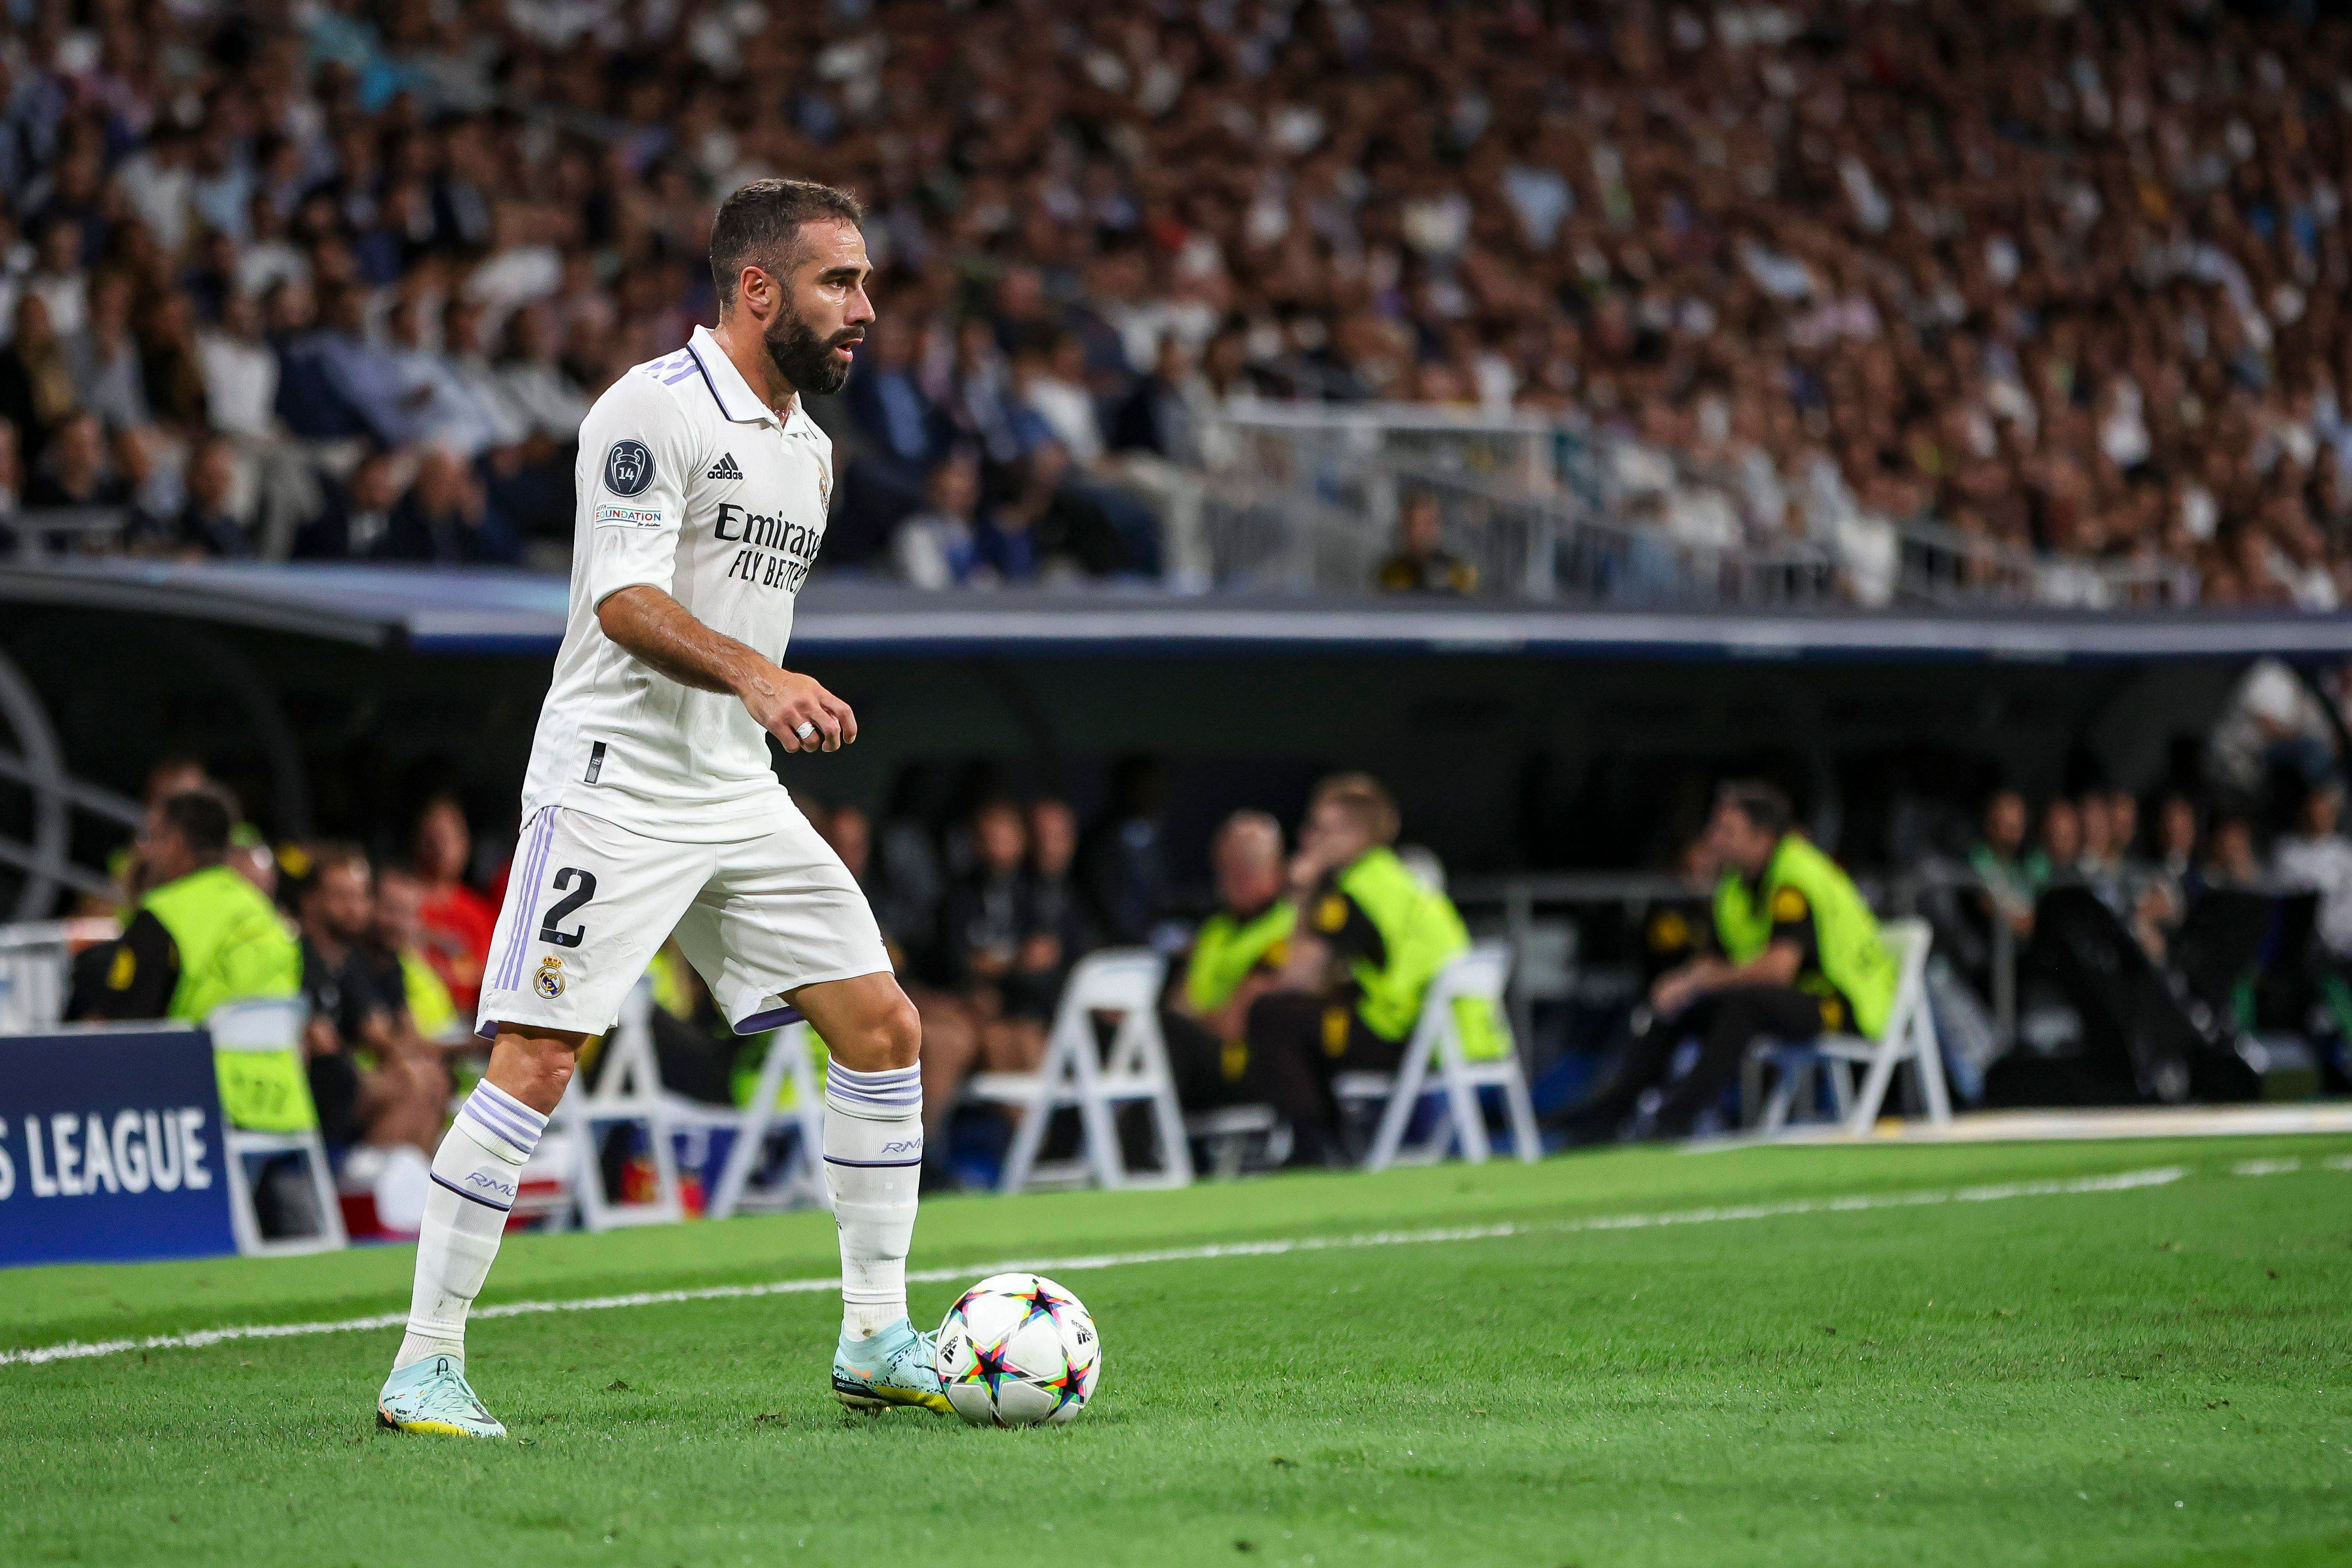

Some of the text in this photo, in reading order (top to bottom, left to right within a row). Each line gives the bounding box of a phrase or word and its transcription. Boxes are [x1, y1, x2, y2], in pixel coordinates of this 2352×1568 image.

[618, 467, 634, 480] 14
[707, 469, 743, 480] adidas
[596, 510, 661, 521] FOUNDATION
[714, 503, 820, 563] Emirate
[728, 550, 764, 582] FLY
[538, 867, 597, 948] 2
[24, 1107, 212, 1197] LEAGUE
[1071, 1319, 1093, 1339] adidas
[940, 1335, 958, 1357] adidas
